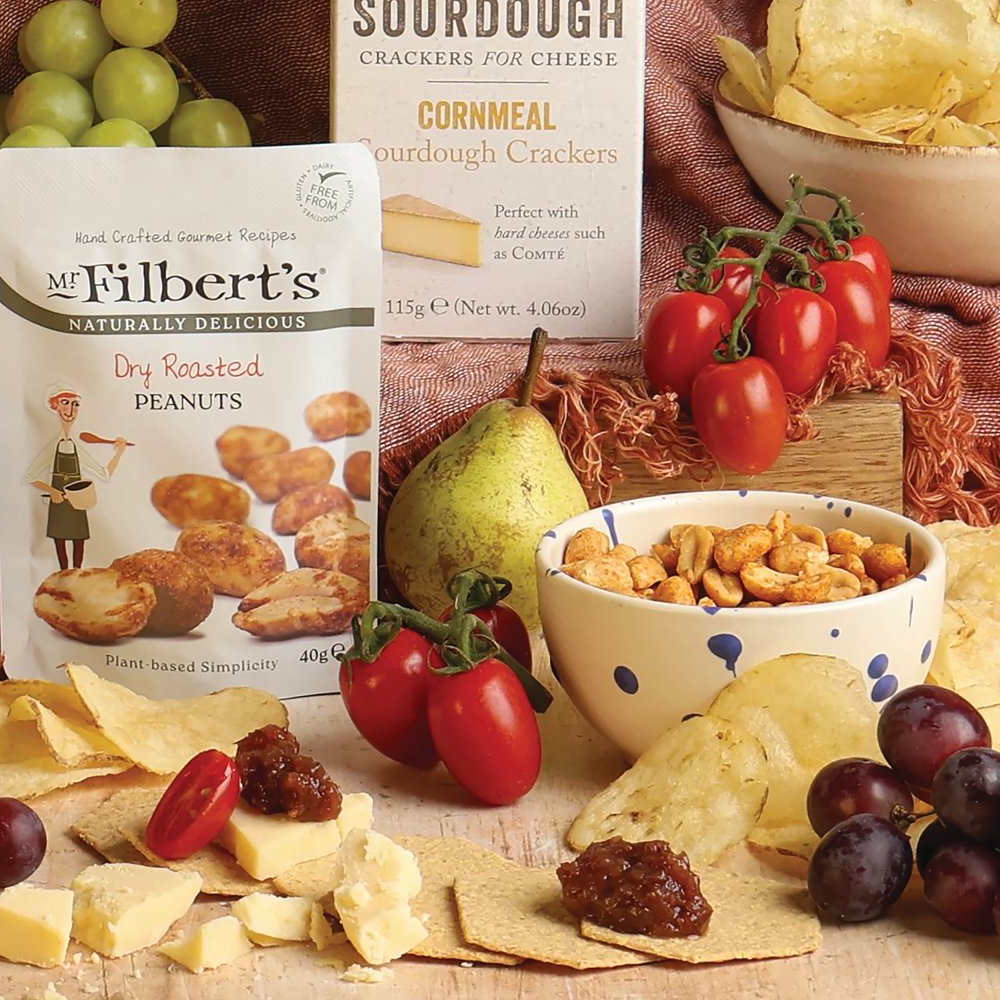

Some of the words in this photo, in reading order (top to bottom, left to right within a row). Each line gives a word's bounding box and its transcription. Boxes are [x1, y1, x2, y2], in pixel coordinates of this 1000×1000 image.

[359, 51, 474, 66] CRACKERS
[482, 51, 523, 66] FOR
[531, 51, 618, 66] CHEESE
[418, 100, 557, 131] CORNMEAL
[359, 137, 496, 170] ourdough
[506, 139, 618, 164] Crackers
[310, 184, 339, 200] FREE
[305, 194, 338, 211] FROM
[494, 205, 543, 218] Perfect
[548, 205, 578, 218] with
[75, 230, 107, 244] Hand
[113, 228, 172, 243] Crafted
[177, 229, 233, 243] Gourmet
[239, 228, 297, 249] Recipes
[494, 226, 525, 239] hard
[528, 226, 570, 239] cheeses
[574, 226, 606, 239] such
[494, 250, 507, 260] as
[386, 299, 425, 319] 115g
[454, 299, 490, 317] (Net
[496, 303, 521, 316] wt.
[526, 300, 587, 318] 4.06oz)
[68, 317, 187, 333] NATURALLY
[195, 315, 307, 331] DELICIOUS
[113, 353, 153, 389] Dry
[162, 353, 265, 380] Roasted
[134, 393, 243, 411] PEANUTS
[105, 654, 196, 673] Plant-based
[201, 658, 279, 675] Simplicity
